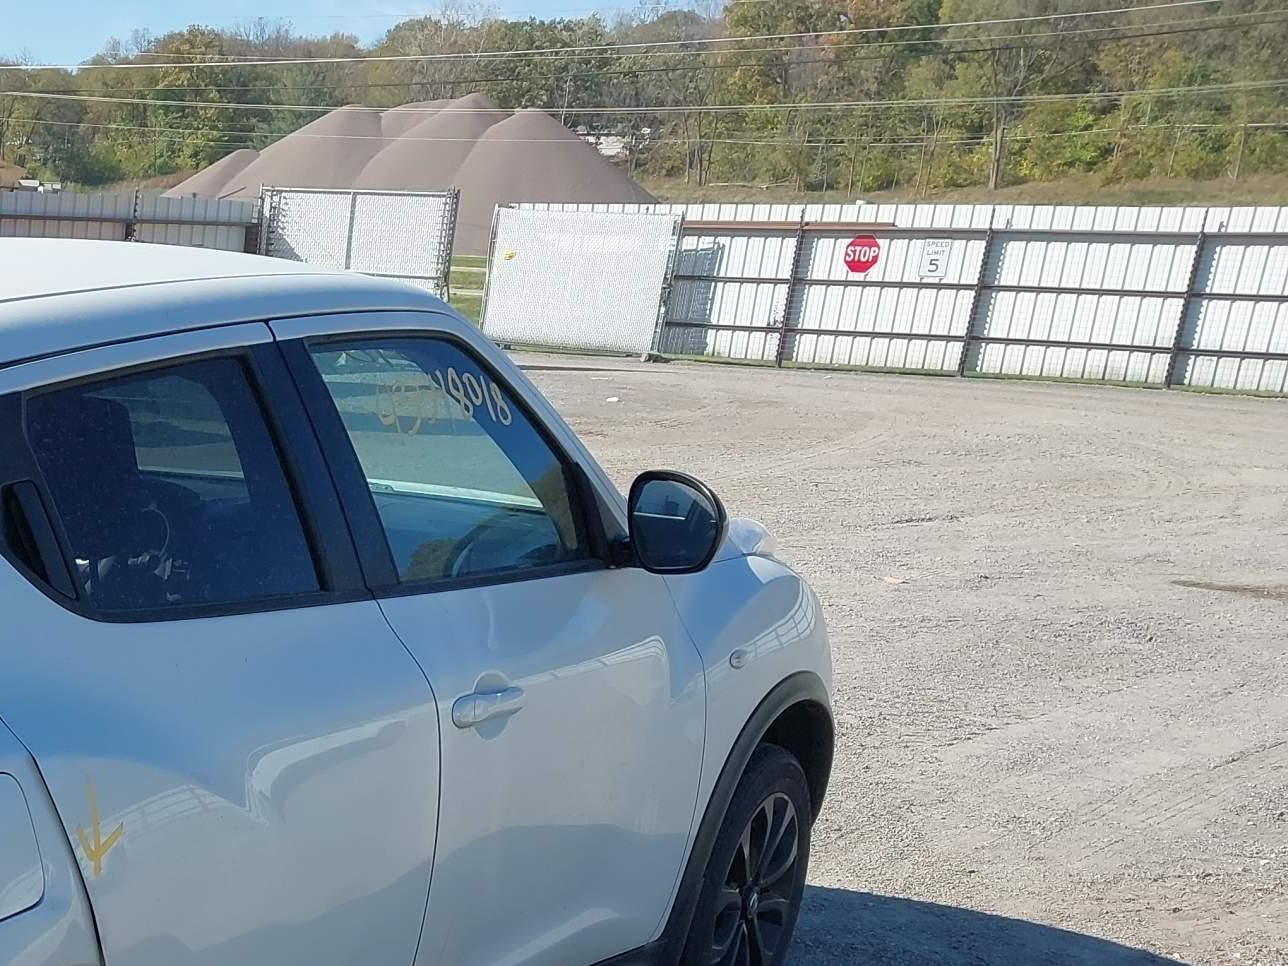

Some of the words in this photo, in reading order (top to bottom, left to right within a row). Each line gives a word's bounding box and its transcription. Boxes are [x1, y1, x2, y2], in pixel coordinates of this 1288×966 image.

[926, 240, 950, 248] SPEED
[845, 245, 879, 262] STOP
[926, 249, 945, 257] LIMIT
[927, 258, 939, 273] 5
